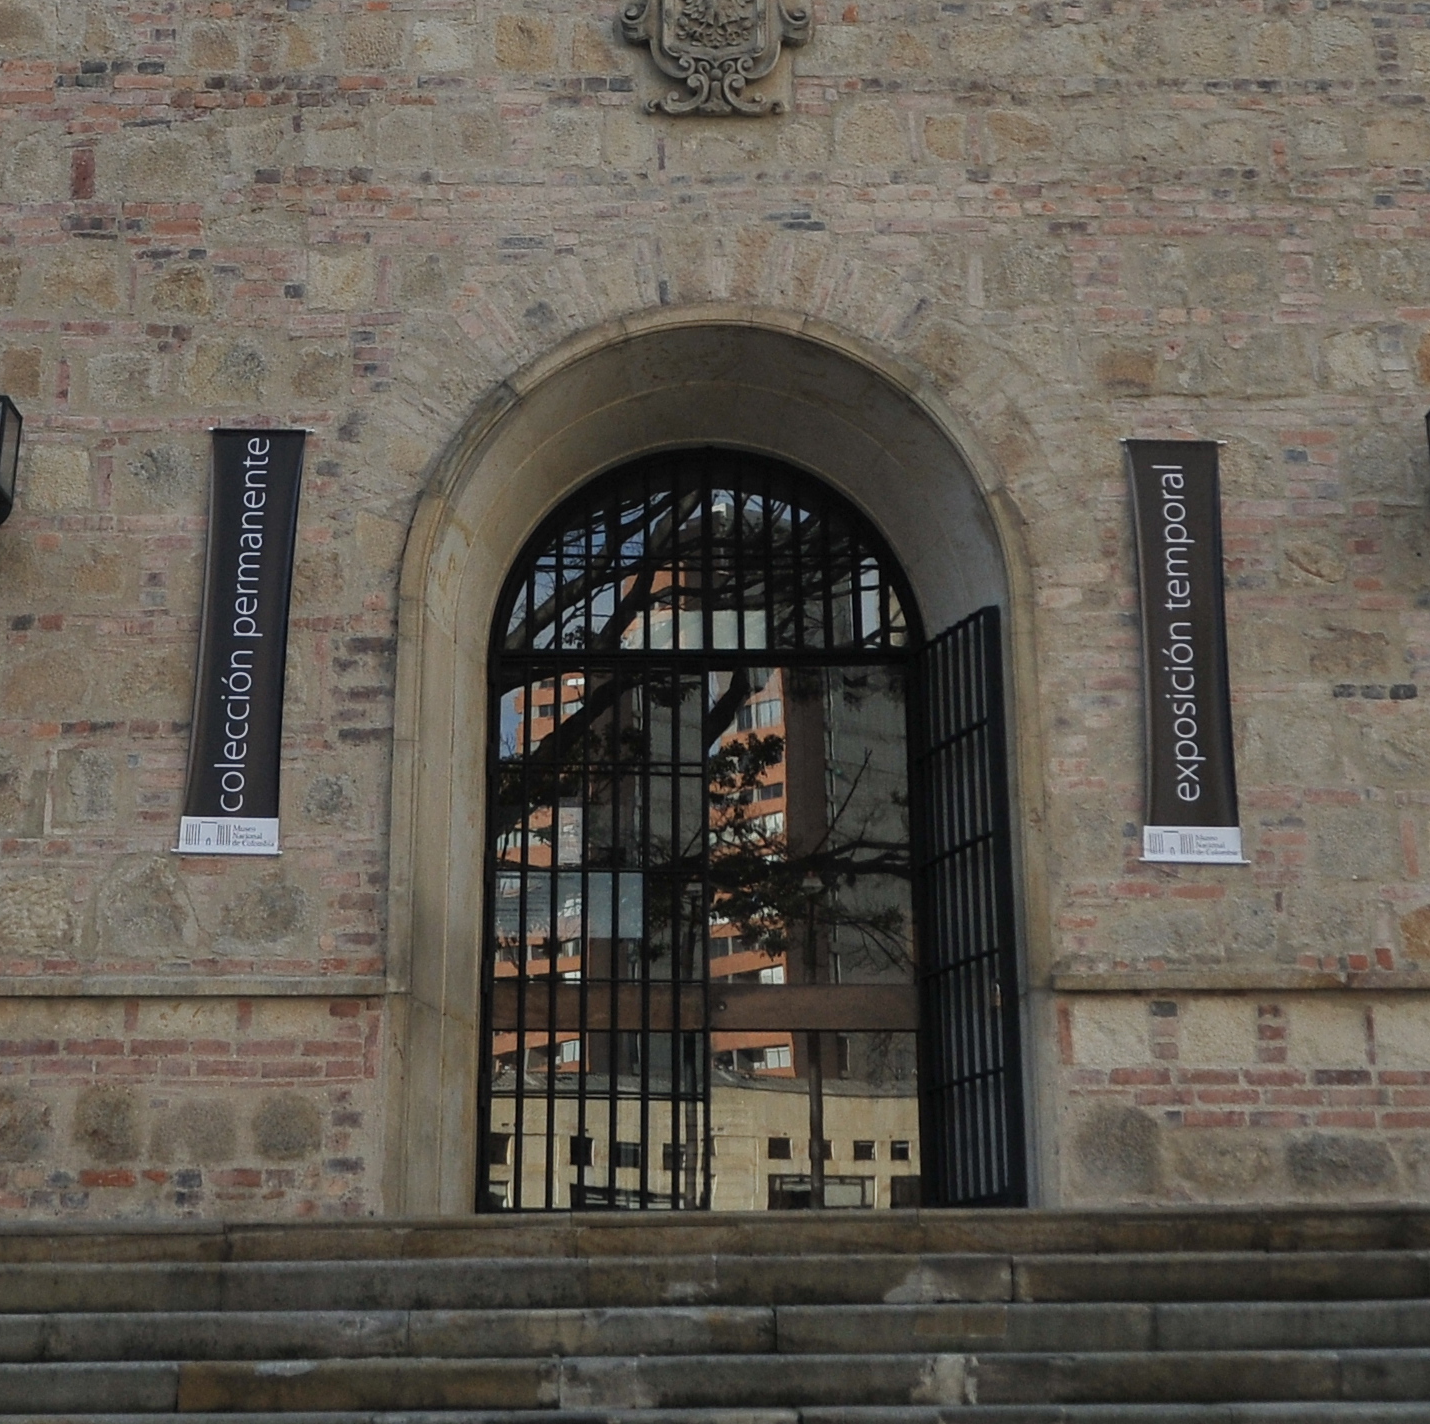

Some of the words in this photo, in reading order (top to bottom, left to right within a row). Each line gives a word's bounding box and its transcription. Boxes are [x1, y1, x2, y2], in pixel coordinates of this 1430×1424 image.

[233, 437, 270, 637] permanente
[1152, 464, 1195, 610] temporal
[214, 650, 253, 812] colección
[1162, 622, 1206, 802] exposición
